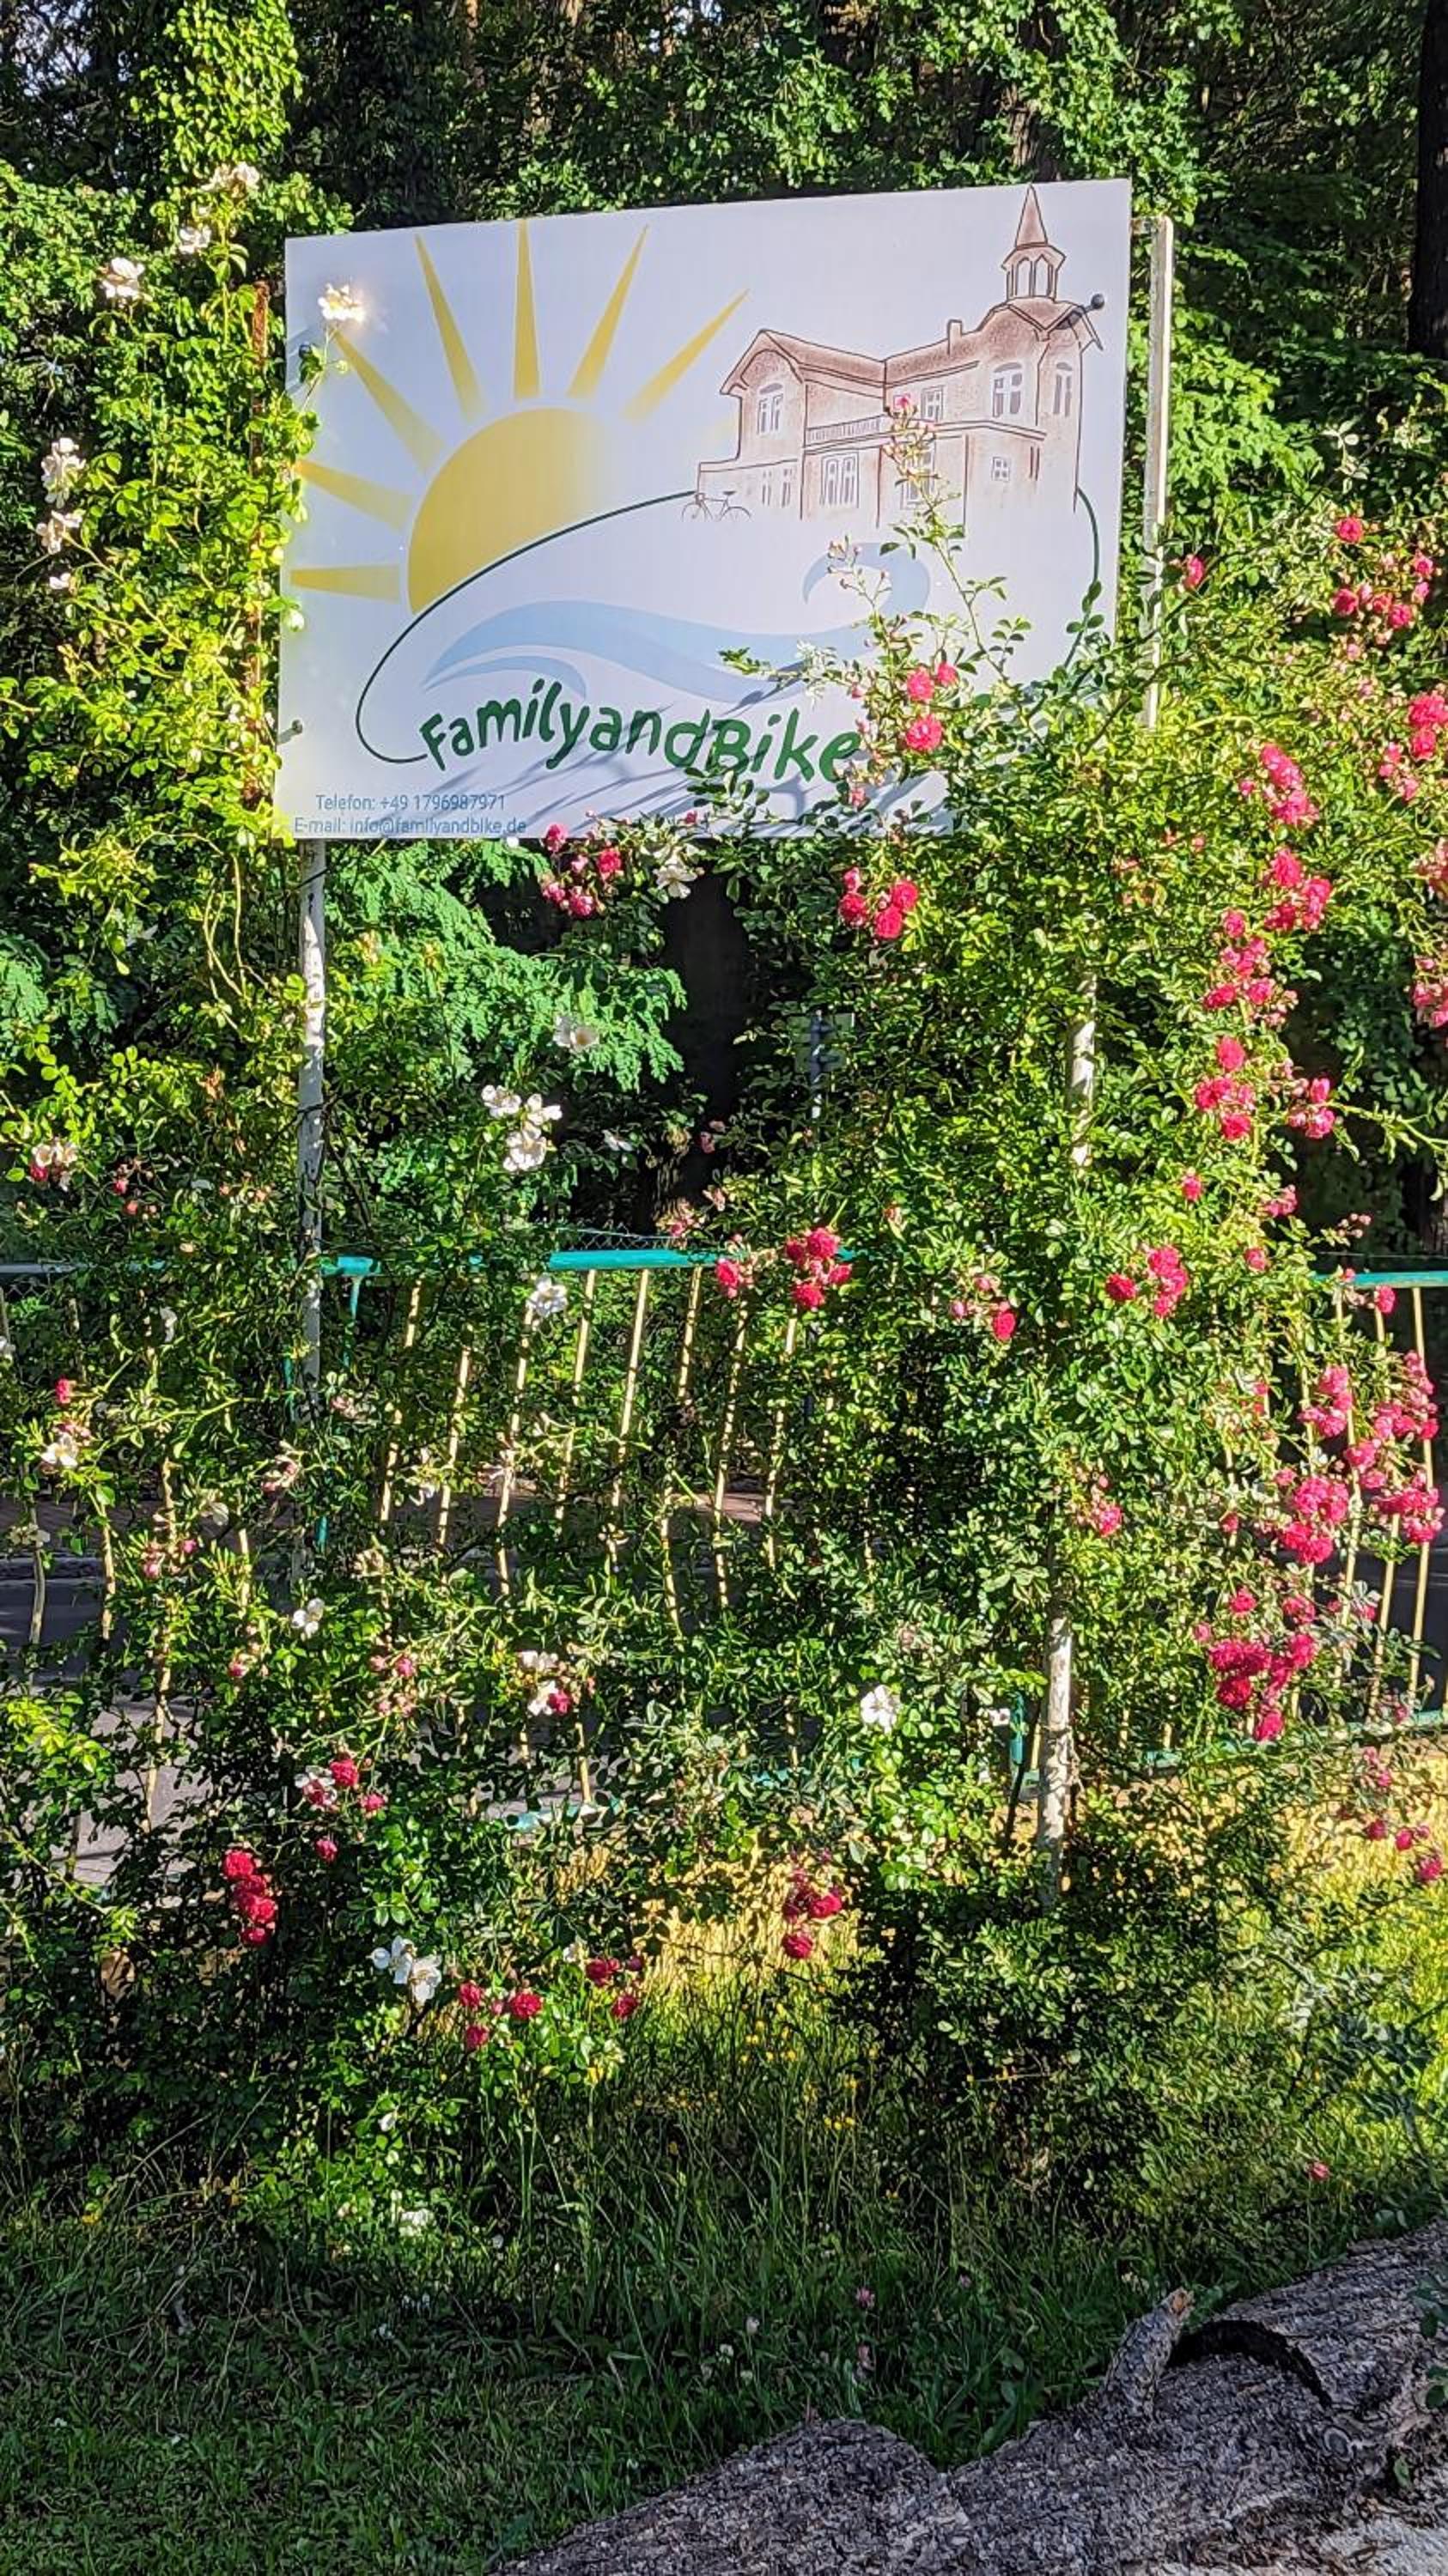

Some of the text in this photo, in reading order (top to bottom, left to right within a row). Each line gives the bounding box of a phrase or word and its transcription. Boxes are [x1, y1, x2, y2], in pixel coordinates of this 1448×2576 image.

[419, 678, 861, 783] FamilyandBike
[315, 793, 505, 811] Telefon: +49 1796987971
[295, 817, 526, 835] E-mail: info@familyandbike.de
